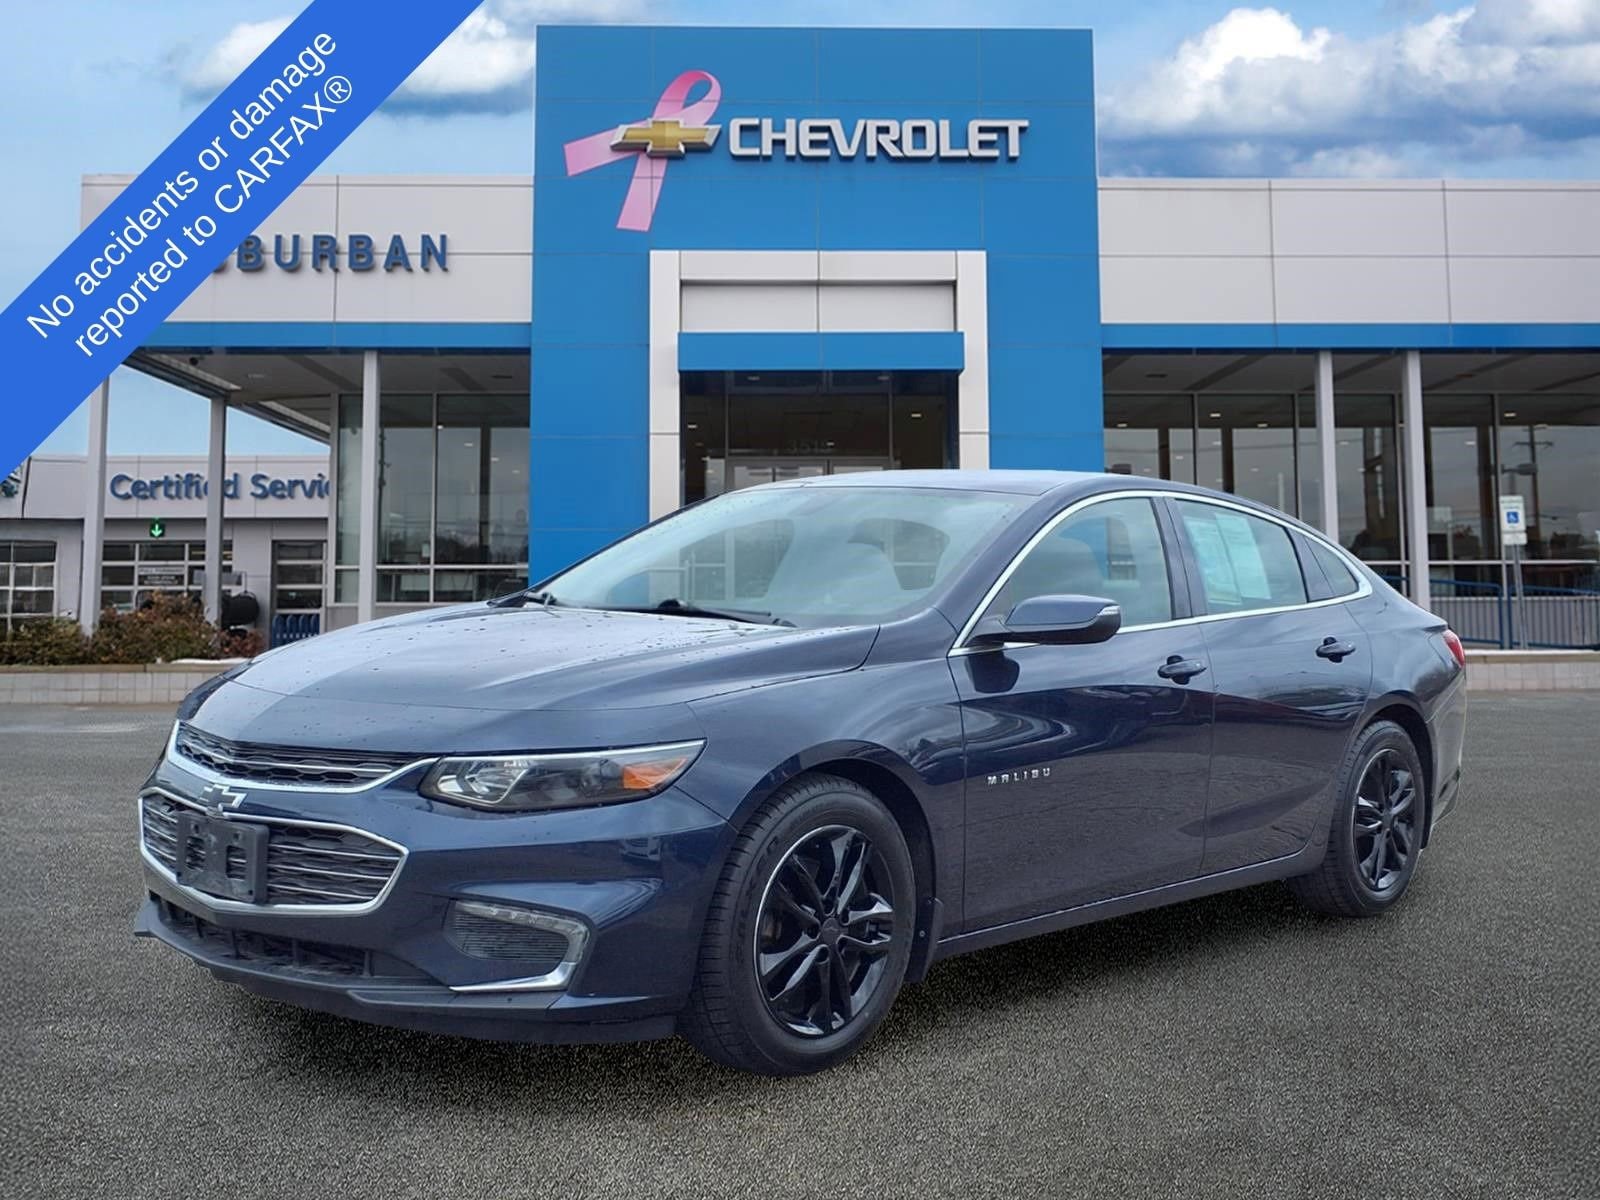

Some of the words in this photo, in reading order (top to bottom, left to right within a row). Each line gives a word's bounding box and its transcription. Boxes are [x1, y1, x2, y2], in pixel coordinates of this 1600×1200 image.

[729, 118, 1029, 161] CHEVROLET
[213, 234, 449, 272] BURBAN
[987, 767, 1050, 785] MALIBU
